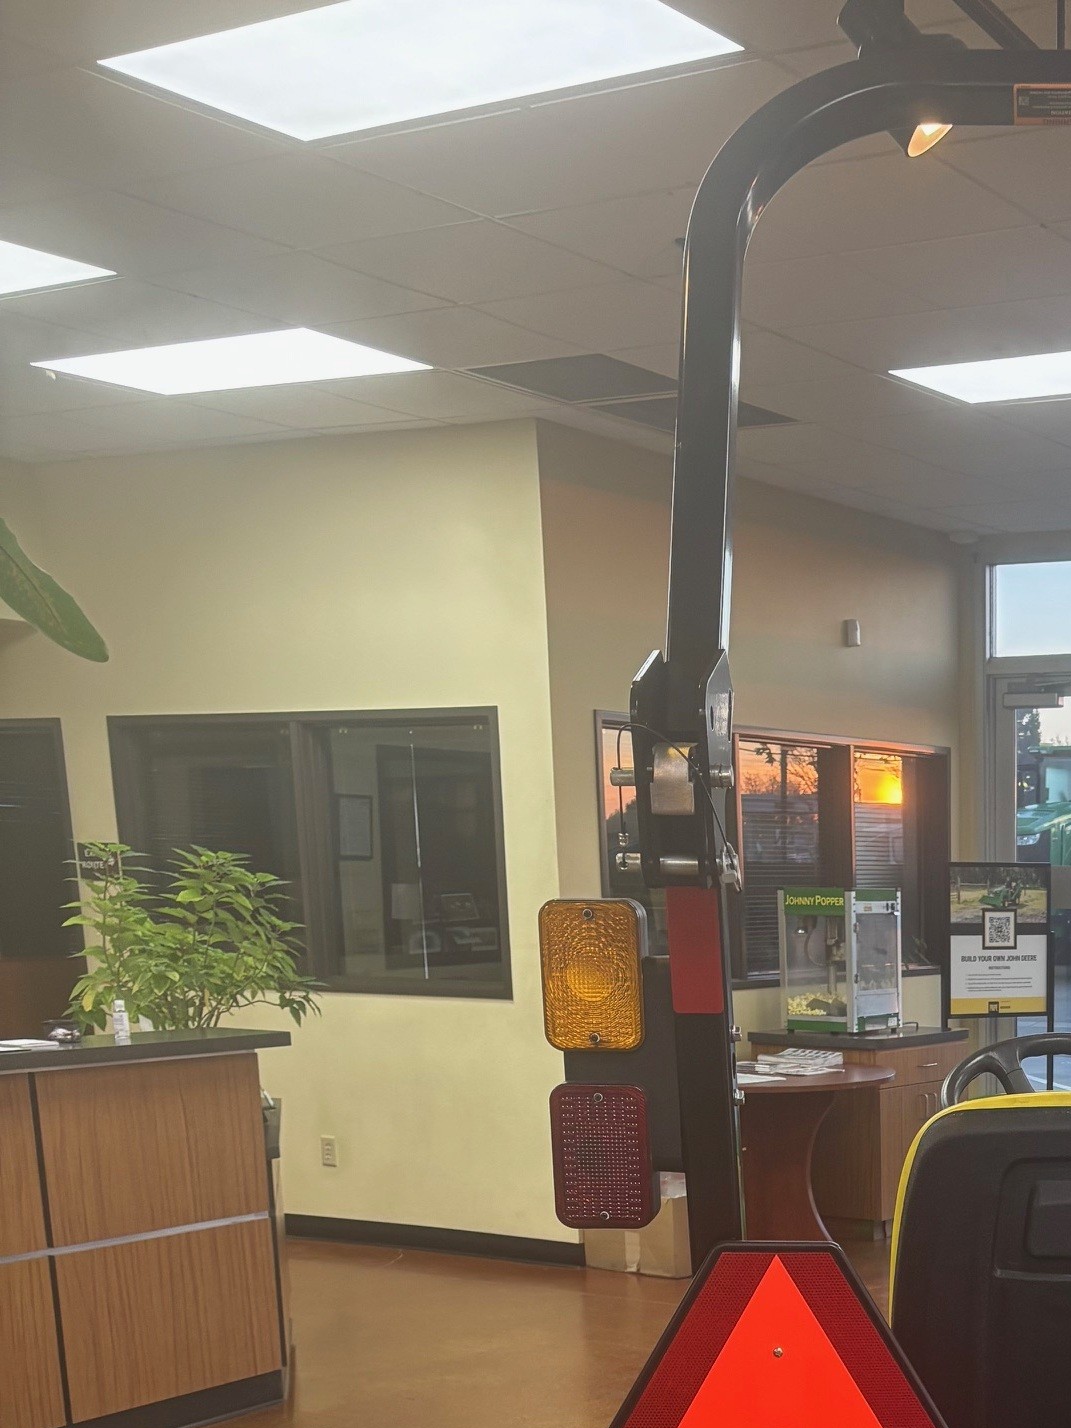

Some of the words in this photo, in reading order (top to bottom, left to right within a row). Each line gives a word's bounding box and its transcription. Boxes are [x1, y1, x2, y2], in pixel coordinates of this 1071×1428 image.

[81, 861, 104, 869] ROUTE
[785, 895, 814, 906] JOHNNY
[815, 895, 844, 906] POPPER
